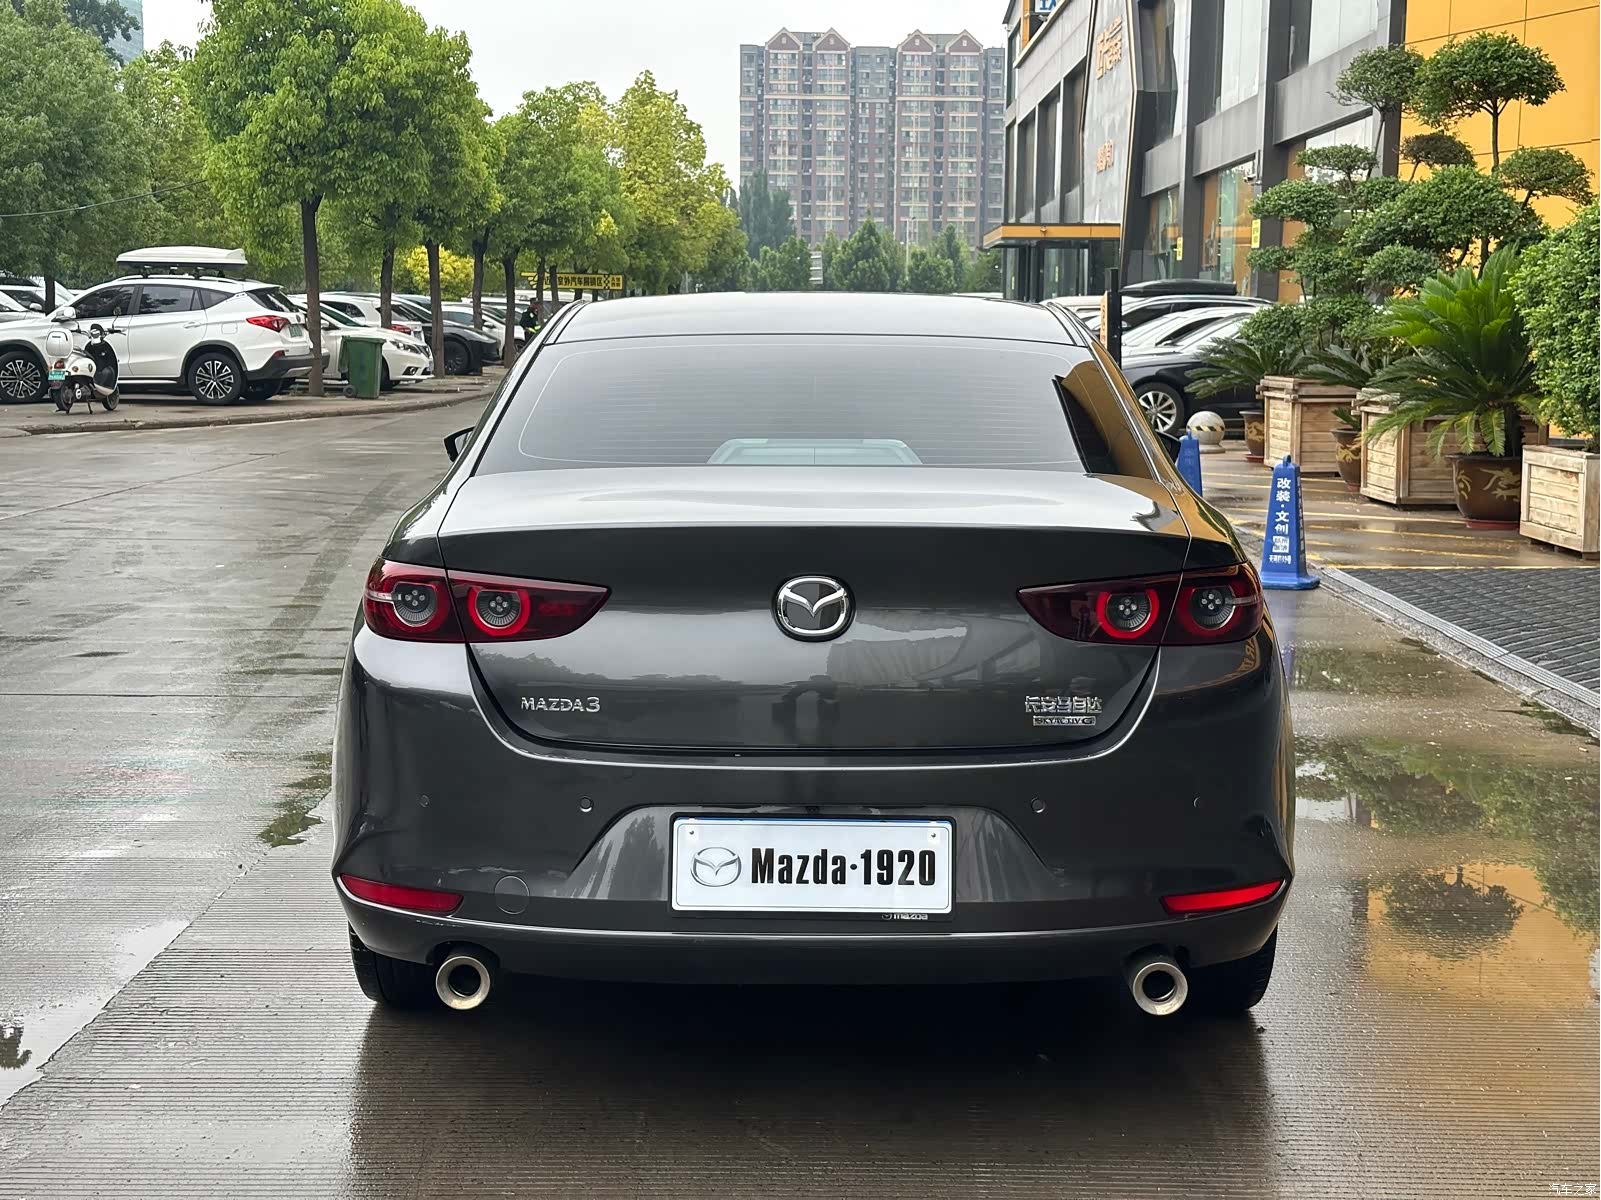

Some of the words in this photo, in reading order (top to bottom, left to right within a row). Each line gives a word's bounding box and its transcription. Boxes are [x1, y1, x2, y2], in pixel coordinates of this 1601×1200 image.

[521, 696, 601, 713] MAZDA3
[1025, 695, 1103, 713] 长安马自达
